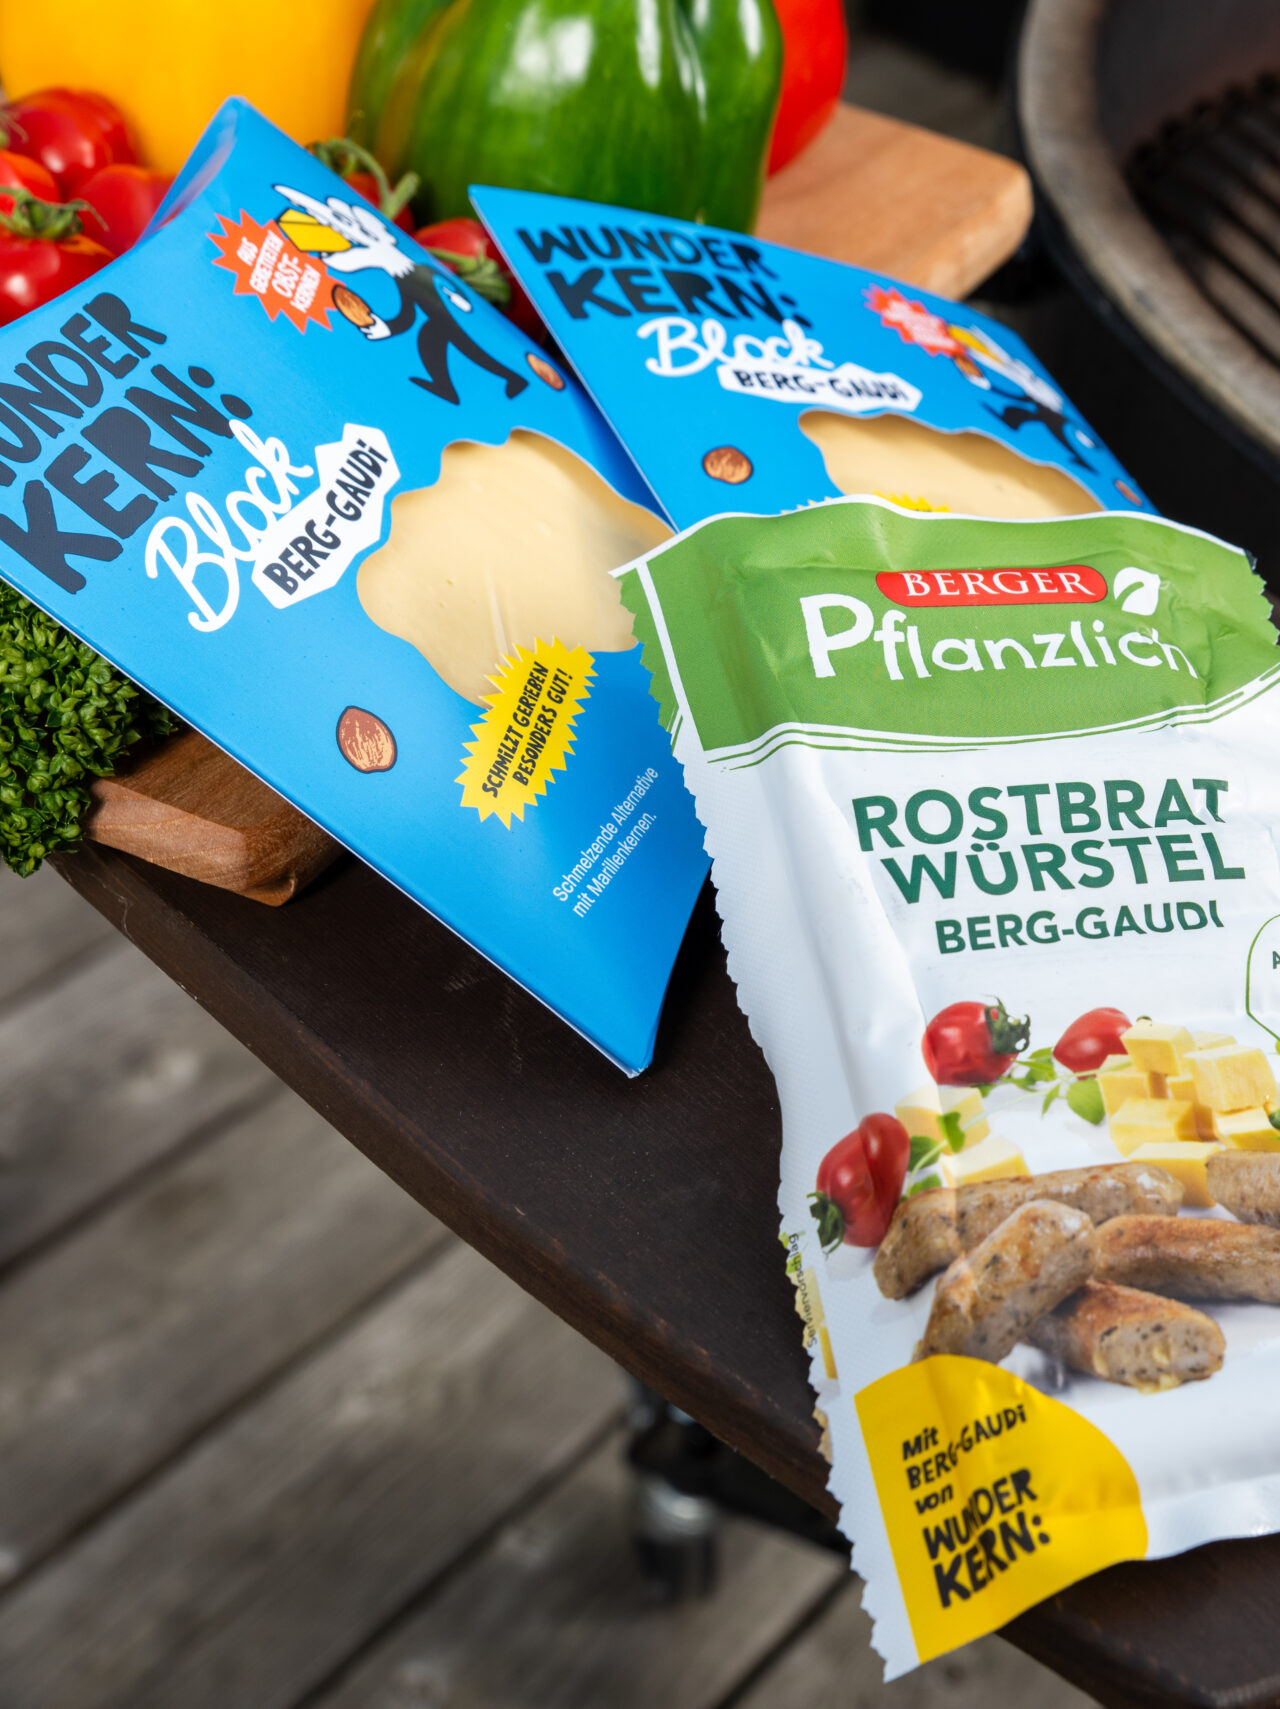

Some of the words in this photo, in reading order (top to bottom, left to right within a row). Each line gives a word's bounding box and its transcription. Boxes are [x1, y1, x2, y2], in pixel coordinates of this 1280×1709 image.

[272, 252, 302, 298] OBST-
[516, 226, 780, 281] WUNDER
[547, 270, 813, 327] KERN:
[637, 316, 834, 377] Block
[0, 293, 167, 487] UNDER
[0, 364, 253, 594] KERN:
[145, 419, 314, 632] Block
[901, 566, 1097, 598] BERGER
[800, 592, 1198, 681] Pflanzlich
[513, 705, 557, 786] BESONDERS
[547, 667, 573, 704] GUT!
[553, 821, 618, 902] Schmelzende
[612, 767, 659, 825] Alternative
[852, 778, 1229, 852] ROSTBRAT
[573, 891, 593, 918] mit
[590, 811, 657, 895] Marillenkernen.
[880, 833, 1246, 904] WÜRSTEL
[935, 901, 1224, 955] BERG-GAUDI
[788, 1233, 817, 1347] Serviervorschlag
[902, 1427, 938, 1461] Mit
[914, 1484, 953, 1515] von
[922, 1469, 1038, 1559] WUNDER
[933, 1511, 1050, 1608] KERN:
